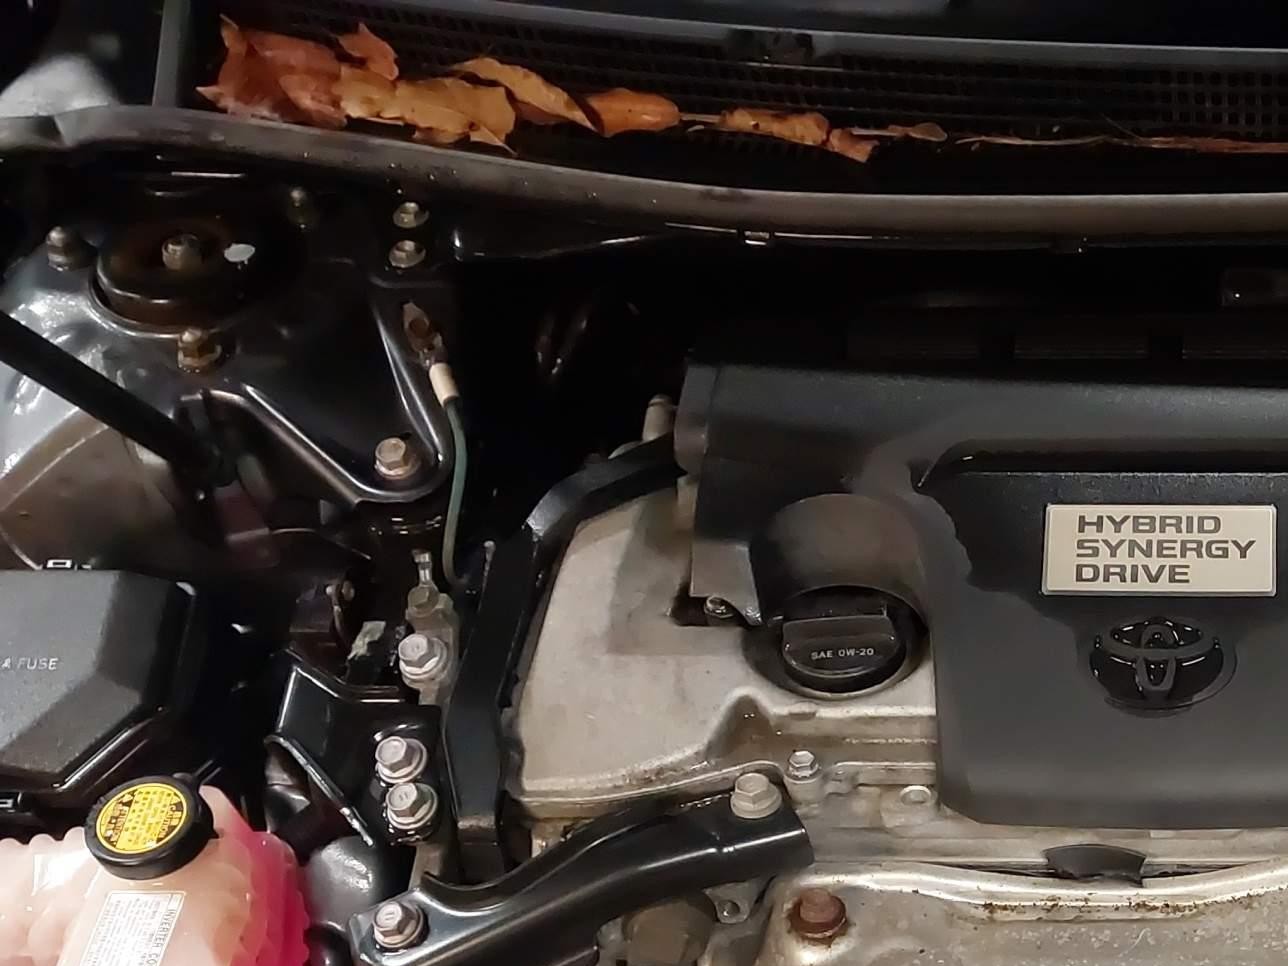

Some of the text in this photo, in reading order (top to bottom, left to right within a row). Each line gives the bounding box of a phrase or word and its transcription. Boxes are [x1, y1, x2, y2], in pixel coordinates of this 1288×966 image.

[1077, 515, 1221, 534] HYBRID
[1076, 539, 1256, 558] SYNERGY
[1075, 564, 1191, 583] DRIVE
[811, 647, 874, 660] SAE 0W-20
[17, 657, 59, 671] FUSE
[152, 909, 177, 948] INVERTER
